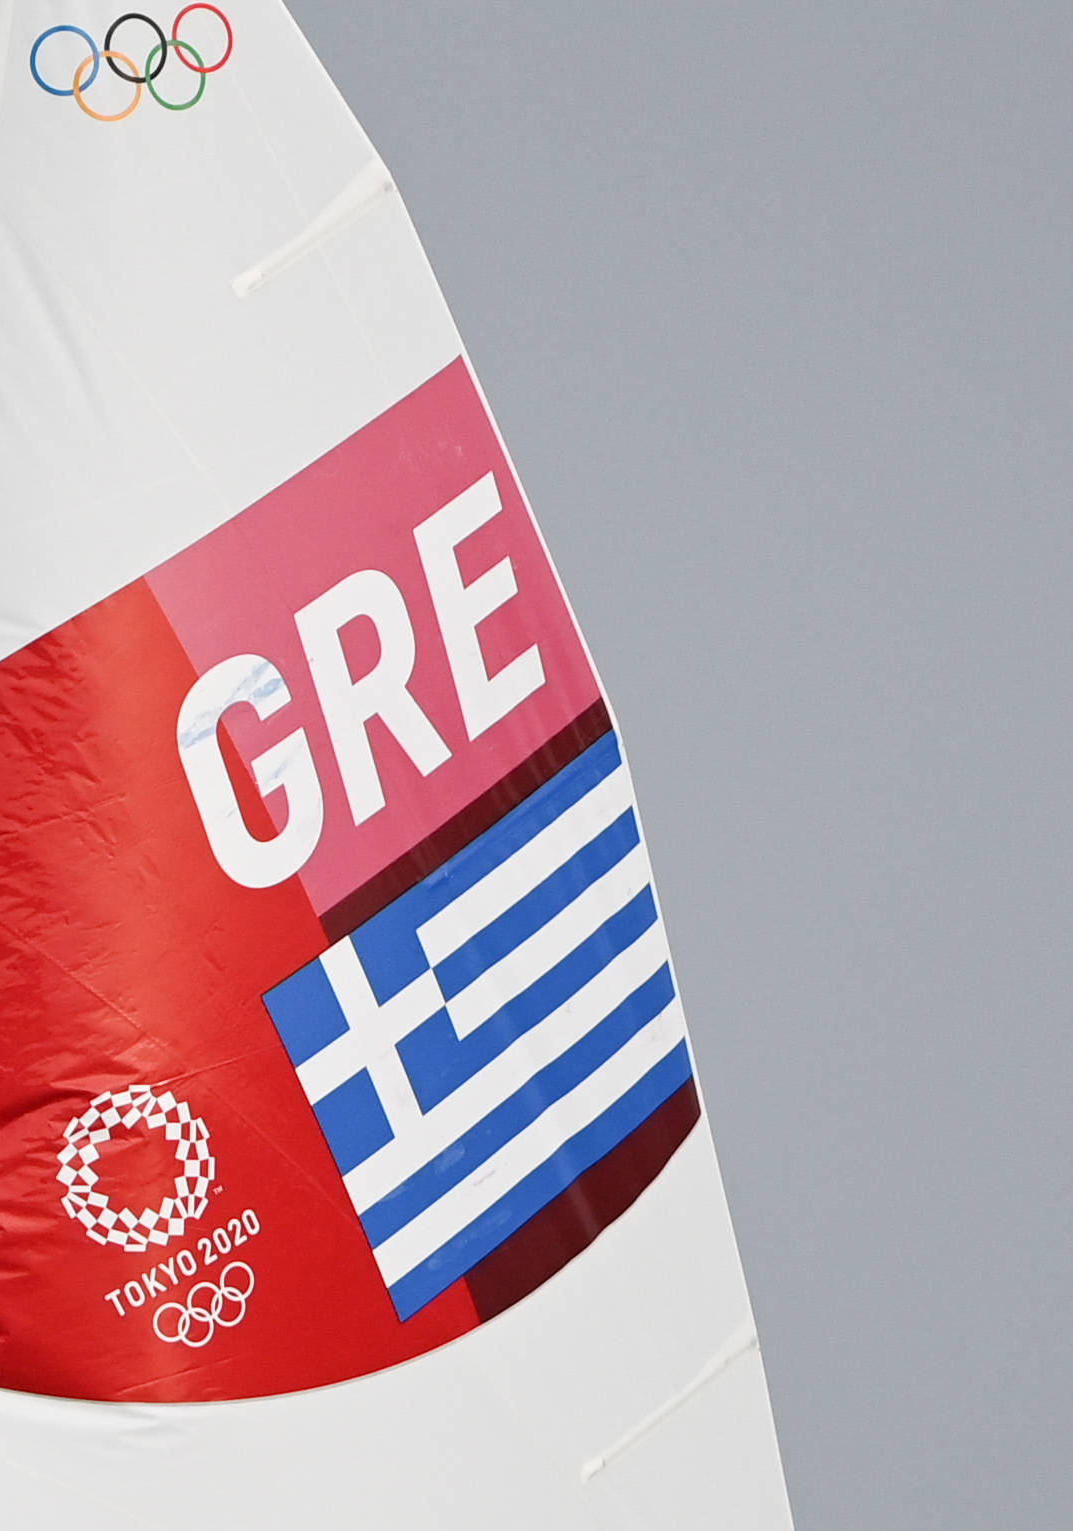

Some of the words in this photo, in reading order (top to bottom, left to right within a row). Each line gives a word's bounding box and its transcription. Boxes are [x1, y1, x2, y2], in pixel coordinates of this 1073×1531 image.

[176, 470, 546, 889] GRE
[104, 1249, 198, 1317] TOKYO
[197, 1208, 261, 1266] 2020
